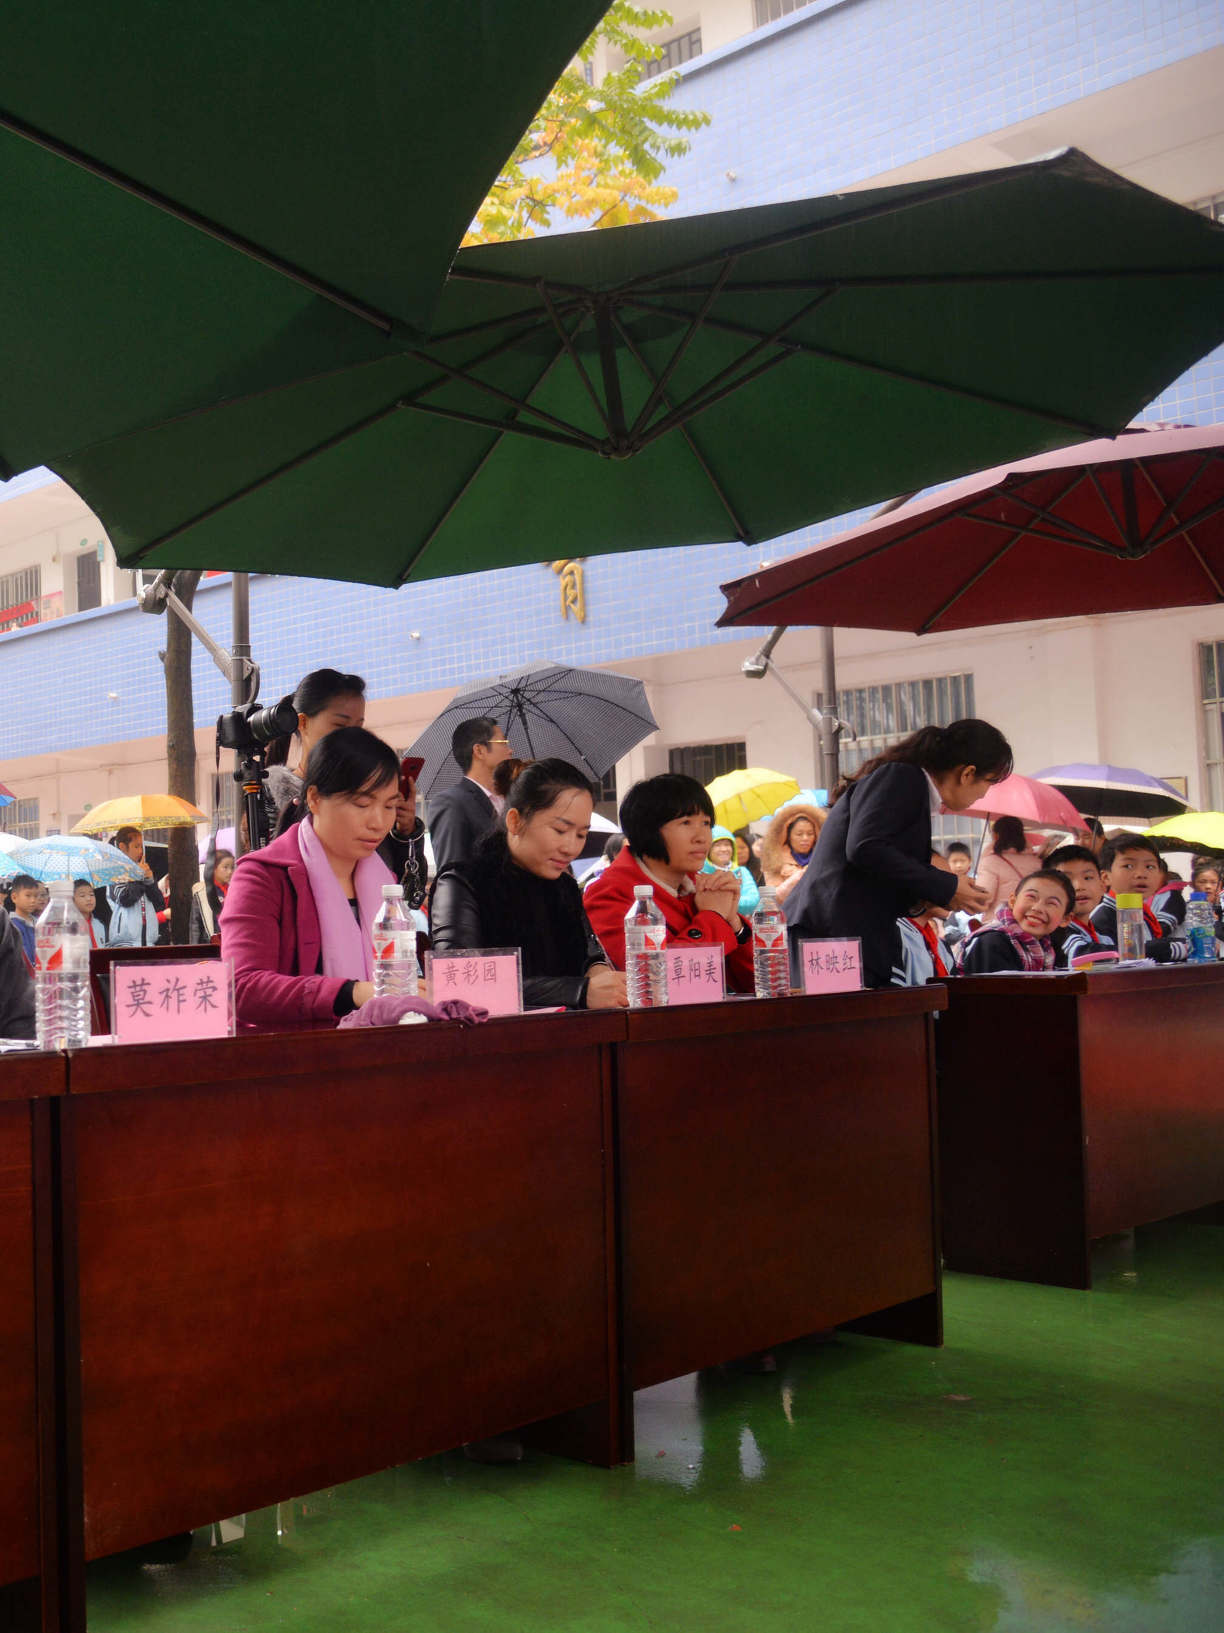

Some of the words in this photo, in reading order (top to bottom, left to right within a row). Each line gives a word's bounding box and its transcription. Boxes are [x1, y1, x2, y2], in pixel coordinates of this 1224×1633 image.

[671, 955, 718, 985] 覃阳美
[808, 951, 857, 976] 林映红
[125, 975, 219, 1018] 莫祚荣
